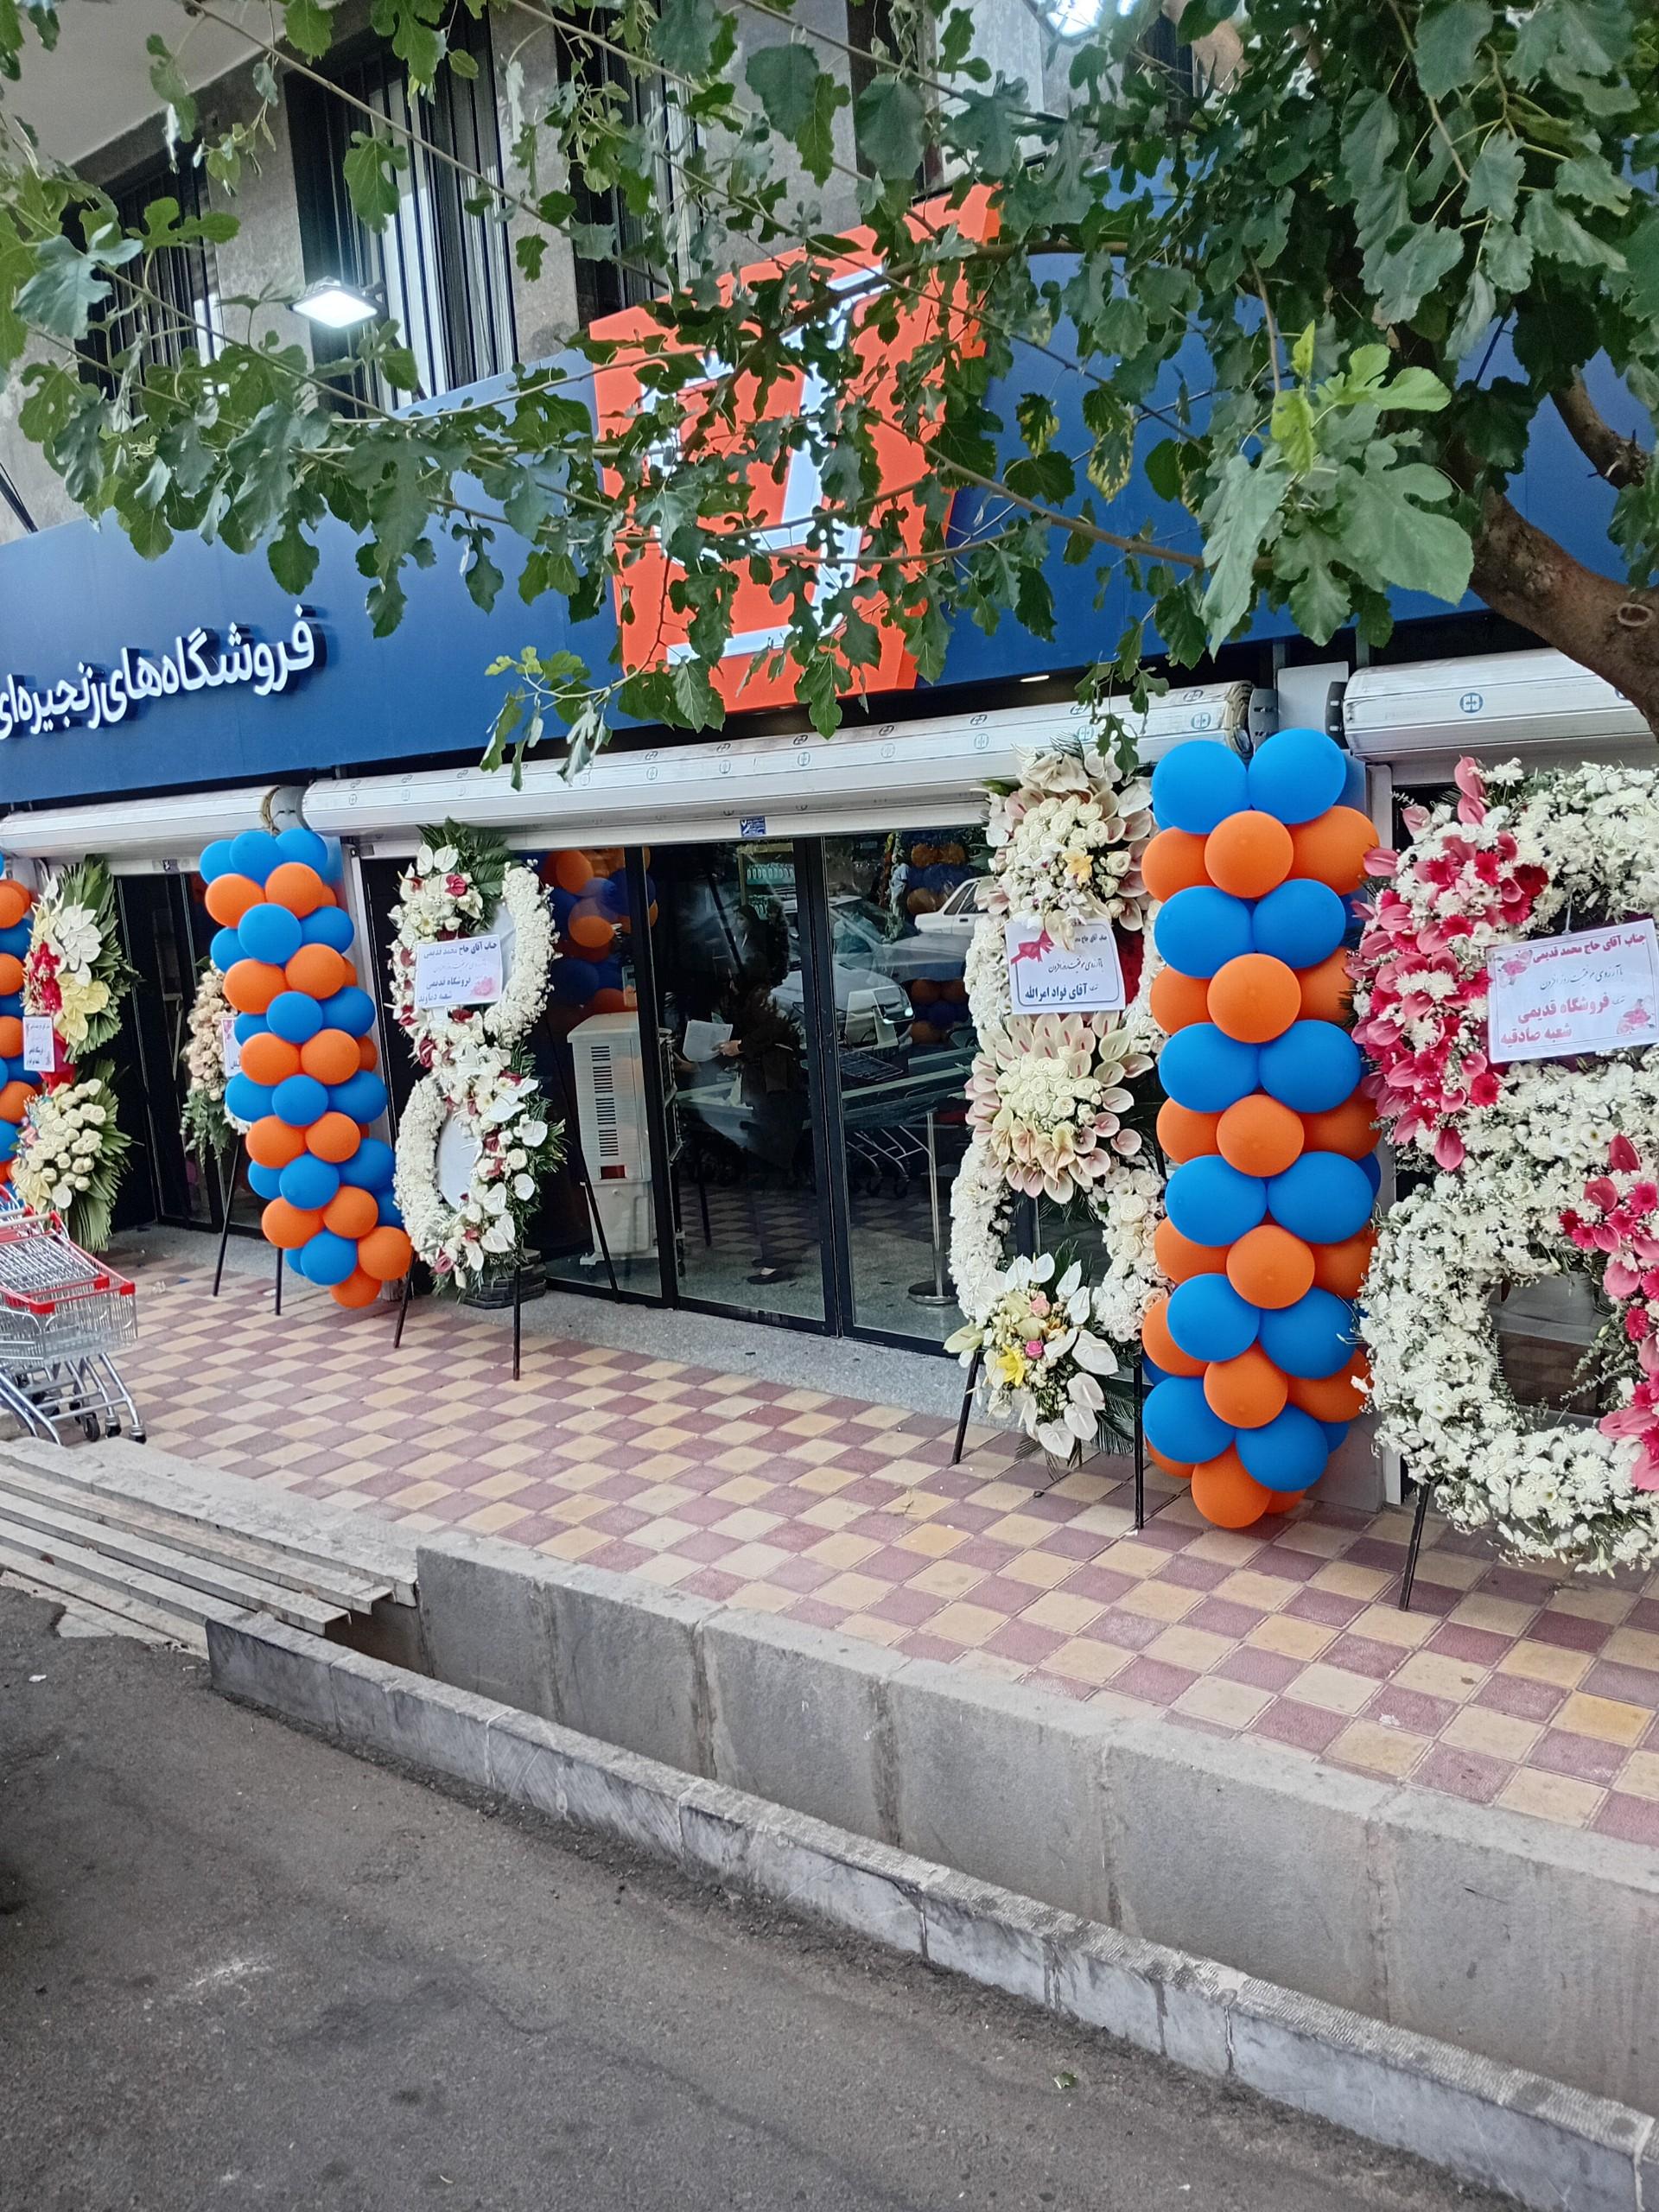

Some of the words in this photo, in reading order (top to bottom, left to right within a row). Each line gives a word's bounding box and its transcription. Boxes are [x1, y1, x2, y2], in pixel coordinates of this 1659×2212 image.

[1584, 940, 1600, 954] حاج
[1603, 935, 1622, 951] آقای
[1624, 933, 1645, 947] جناب
[1533, 946, 1559, 963] قدیمی
[1560, 946, 1582, 956] محمد
[1052, 984, 1067, 1001] فواد
[1069, 982, 1087, 1000] آقای
[1517, 999, 1557, 1024] قدیمی
[1560, 991, 1610, 1015] فروشگاه
[1500, 1027, 1541, 1048] صادقیه
[1544, 1022, 1573, 1043] شعبه
